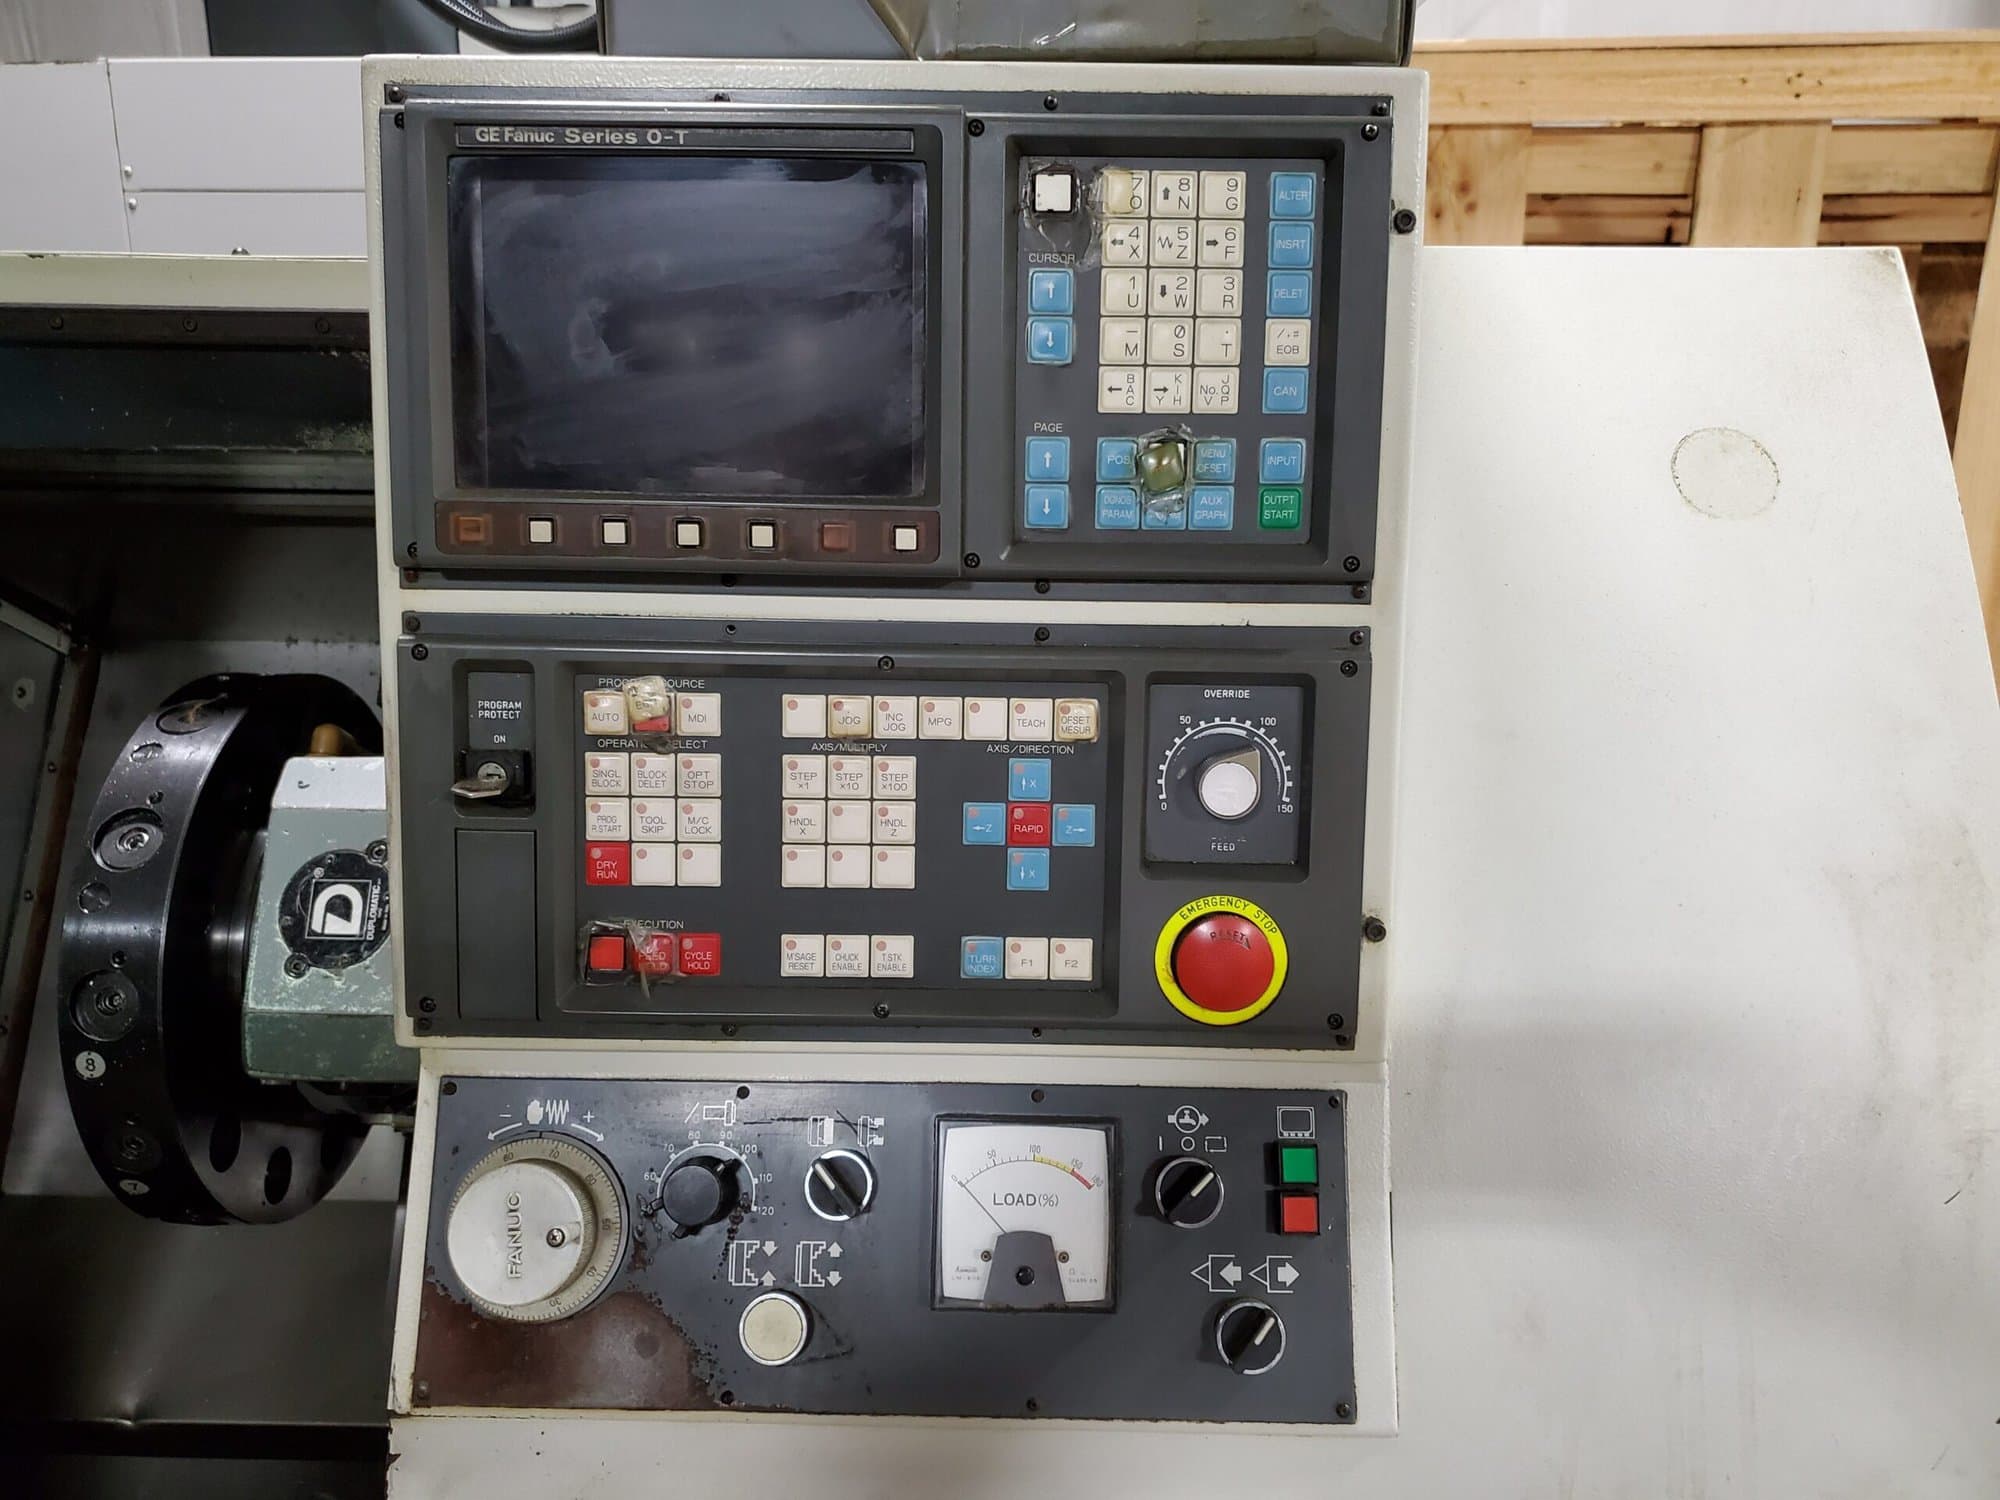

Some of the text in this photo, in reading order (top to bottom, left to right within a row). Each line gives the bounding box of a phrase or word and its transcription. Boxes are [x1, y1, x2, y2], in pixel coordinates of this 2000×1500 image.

[475, 127, 501, 142] GE
[504, 127, 554, 143] Fanuc
[564, 128, 638, 145] Series
[1131, 177, 1143, 191] 7
[1178, 177, 1191, 191] 8
[1226, 178, 1239, 192] 9
[1279, 190, 1308, 201] ALTER
[1178, 195, 1191, 209] N
[1225, 195, 1239, 210] G
[1128, 226, 1140, 240] 4
[1177, 226, 1189, 241] 5
[1224, 227, 1237, 241] 6
[1276, 239, 1305, 249] INSRT
[1128, 245, 1141, 259] X
[1176, 245, 1188, 259] Z
[1224, 245, 1236, 259] F
[1028, 253, 1075, 264] CURSOR
[1129, 276, 1137, 290] 1
[1176, 276, 1188, 291] 2
[1223, 277, 1235, 291] 3
[1274, 289, 1303, 299] DELET
[1127, 294, 1139, 308] U
[1174, 294, 1188, 308] W
[1223, 294, 1234, 309] R
[1125, 343, 1138, 357] M
[1173, 343, 1185, 357] S
[1221, 343, 1233, 357] T
[1276, 345, 1300, 355] EOB
[1127, 374, 1135, 384] B
[1175, 374, 1183, 384] K
[1222, 374, 1230, 384] J
[1126, 385, 1135, 394] A
[1200, 385, 1218, 395] No.
[1221, 385, 1230, 395] Q
[1273, 386, 1297, 397] CAN
[1125, 396, 1135, 406] C
[1155, 397, 1164, 406] Y
[1173, 396, 1182, 406] H
[1204, 397, 1213, 406] V
[1221, 397, 1229, 406] P
[1034, 423, 1063, 433] PAGE
[1200, 448, 1226, 457] MENU
[1107, 456, 1130, 465] POS
[1267, 456, 1297, 466] INPUT
[1200, 496, 1223, 505] AUX
[1264, 496, 1294, 505] OUTPT
[1102, 510, 1134, 519] PARAM
[1195, 511, 1226, 520] GRAPH
[1263, 510, 1294, 520] START
[664, 680, 704, 689] OURCE
[1204, 689, 1250, 699] OVERRIDE
[478, 701, 522, 710] PROGRAM
[478, 710, 520, 719] PROTECT
[591, 713, 619, 722] AUTO
[688, 714, 707, 723] MDI
[885, 713, 903, 722] INC
[838, 716, 861, 725] JOG
[928, 718, 952, 727] MPG
[1016, 719, 1046, 728] TEACH
[1061, 716, 1091, 724] OFSET
[1179, 715, 1277, 726] 50 100
[883, 723, 906, 731] JOG
[1061, 726, 1090, 734] MESUR
[493, 735, 506, 743] ON
[986, 745, 1074, 754] AXIS/DIRECTION
[637, 770, 667, 779] BLOCK
[687, 771, 710, 780] OPT
[790, 772, 817, 781] STEP
[835, 773, 863, 781] STEP
[881, 773, 909, 782] STEP
[592, 779, 622, 788] BLOCK
[638, 780, 666, 788] DELET
[684, 781, 714, 789] STOP
[1030, 779, 1037, 788] X
[1160, 803, 1293, 813] 0 150
[639, 816, 667, 825] TOOL
[687, 817, 709, 825] M/C
[789, 818, 816, 826] HNDL
[880, 818, 907, 827] HNDL
[641, 826, 664, 834] SKIP
[684, 826, 712, 834] LOCK
[799, 827, 807, 835] X
[890, 829, 897, 837] Z
[985, 824, 992, 833] Z
[1014, 825, 1043, 834] RAPID
[1065, 826, 1073, 834] Z
[1211, 843, 1235, 851] FEED
[596, 861, 617, 870] DRY
[597, 870, 618, 879] RUN
[1029, 869, 1036, 878] X
[366, 884, 381, 940] DUPLOMATIC
[1179, 896, 1278, 934] EMERGENCY STOP
[685, 952, 712, 960] CYCLE
[835, 953, 859, 962] CHUCK
[970, 955, 997, 964] TURR
[688, 961, 711, 969] HOLD
[788, 962, 815, 971] RESET
[832, 963, 863, 971] ENABLE
[877, 963, 907, 972] ENABLE
[1021, 959, 1033, 967] F1
[1065, 960, 1078, 968] F2
[968, 965, 996, 974] INDEX
[86, 1058, 96, 1072] 8
[688, 1131, 701, 1140] 80
[720, 1131, 733, 1140] 90
[664, 1144, 674, 1153] 70
[741, 1144, 758, 1154] 100
[987, 1150, 996, 1159] 50
[1029, 1144, 1041, 1154] 100
[643, 1173, 656, 1181] 60
[759, 1173, 772, 1182] 110
[758, 1207, 774, 1215] 120
[507, 1191, 522, 1279] FANUC
